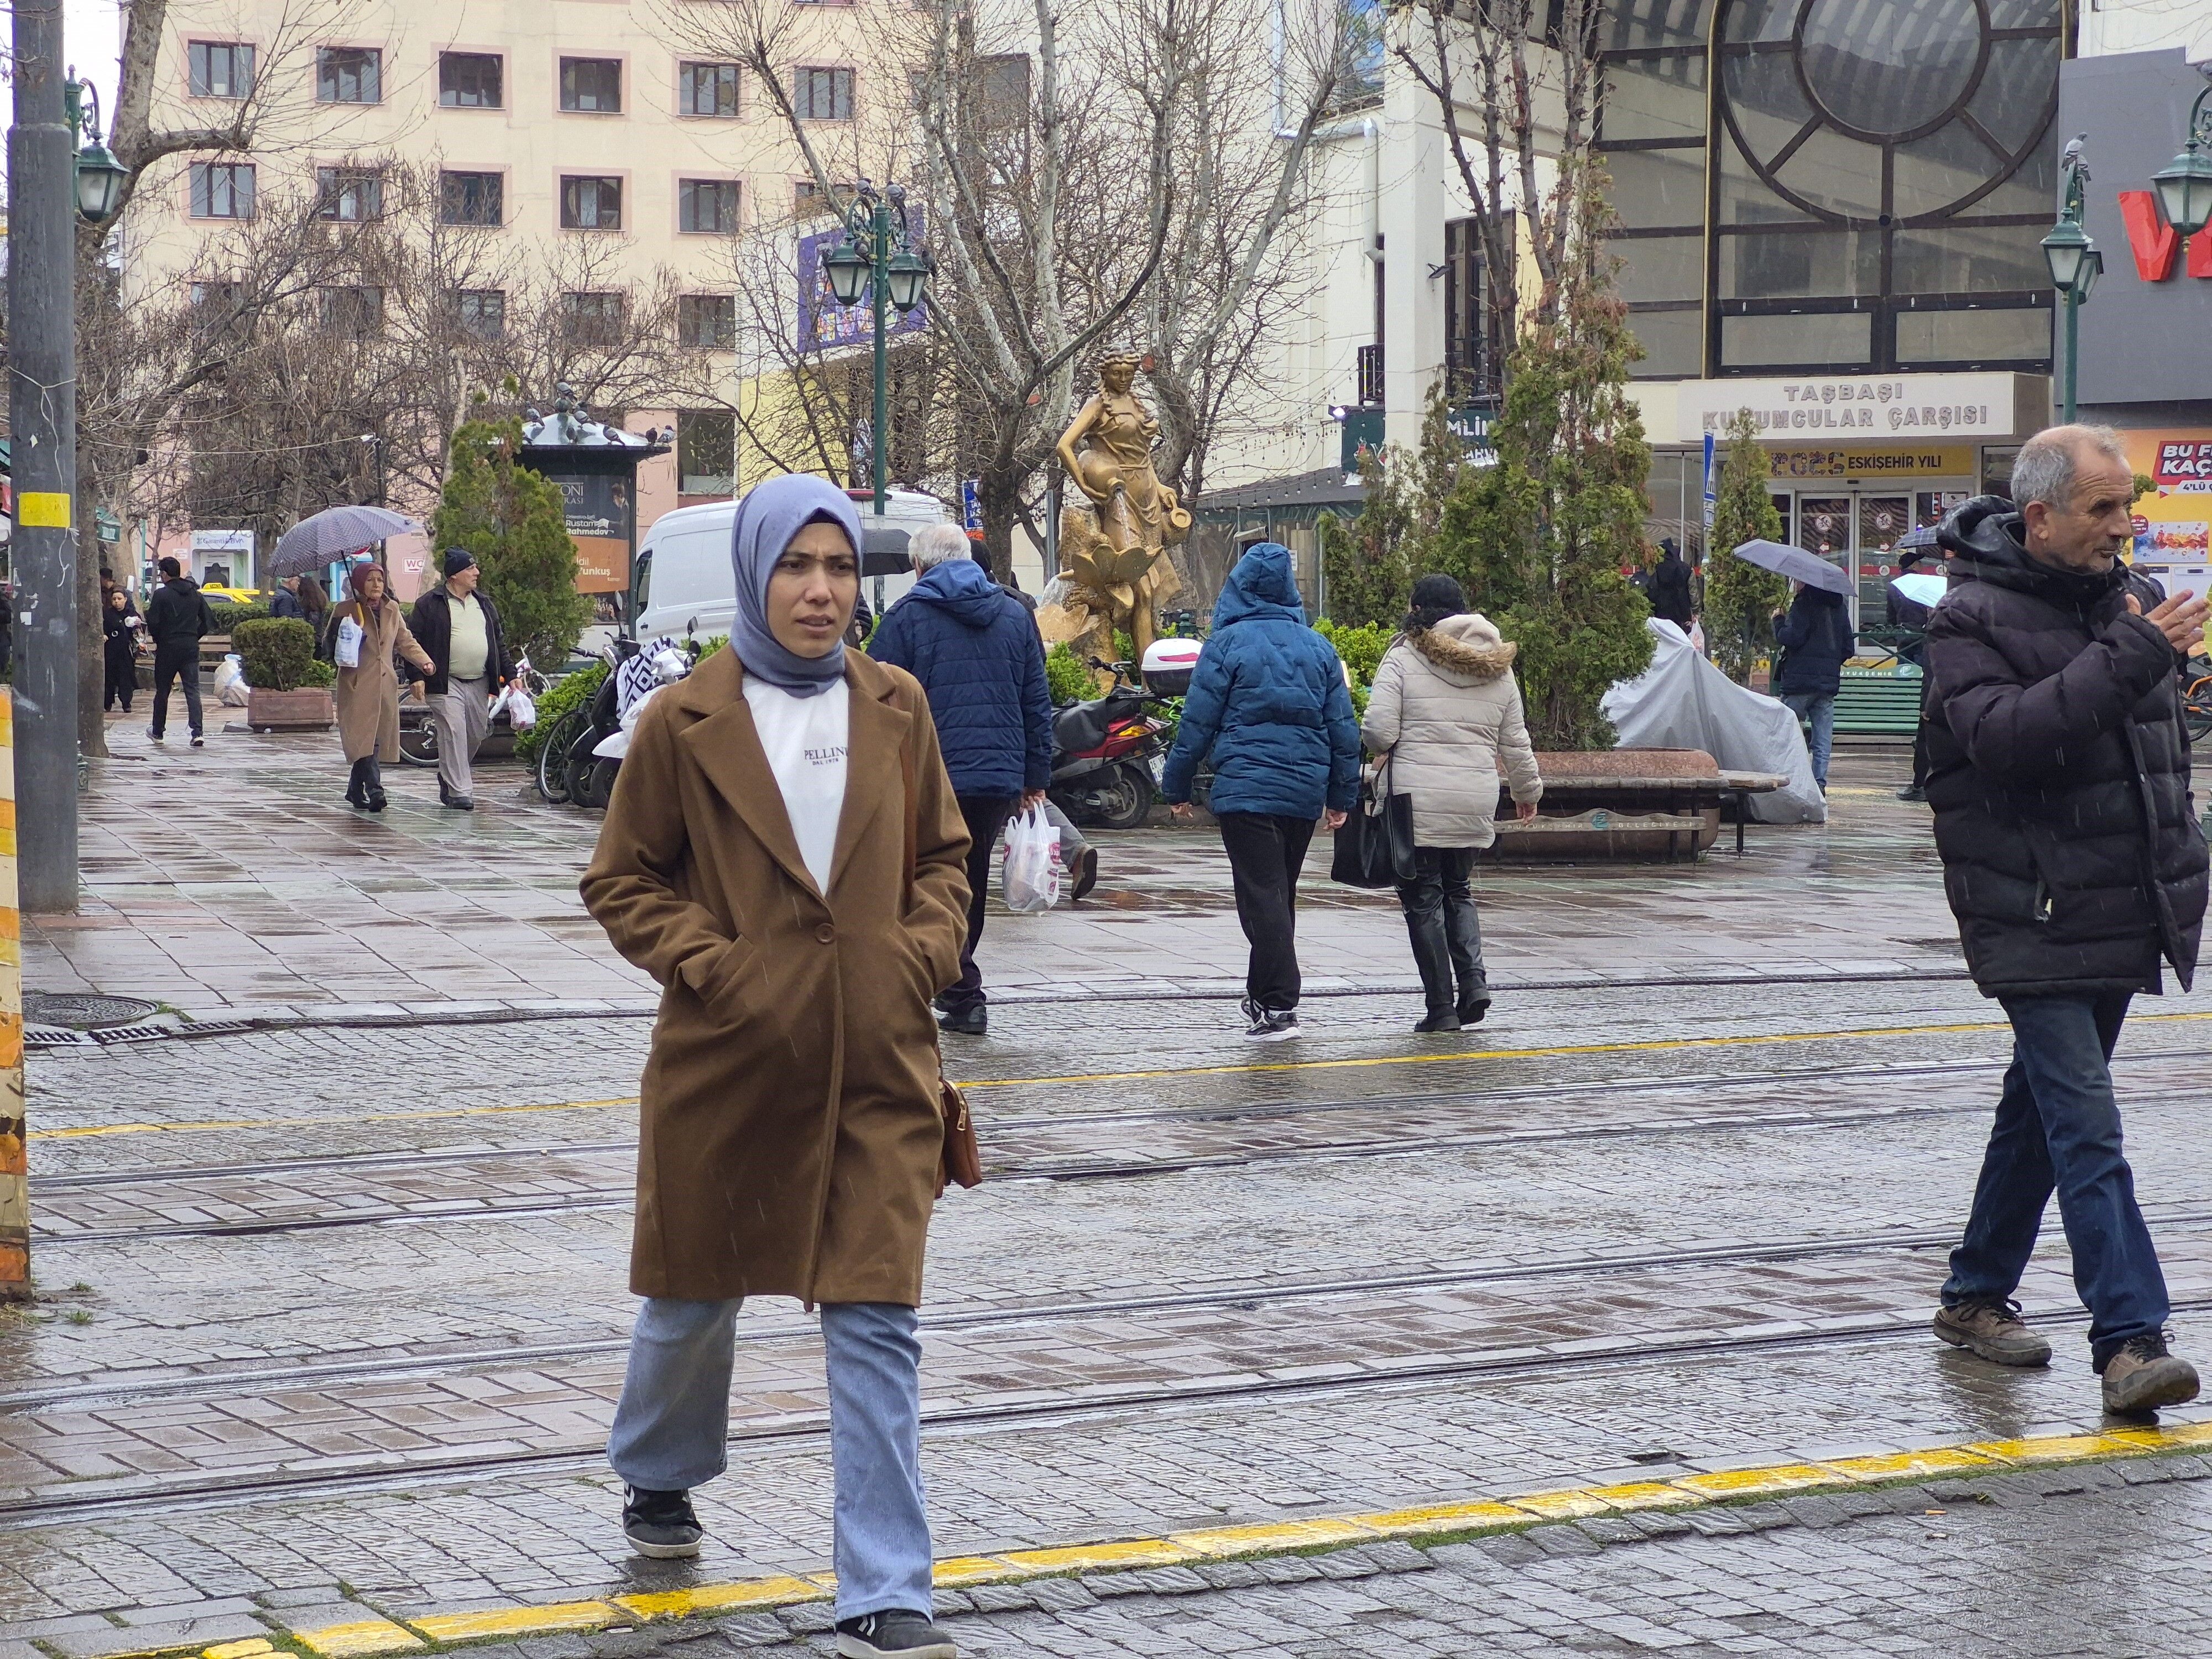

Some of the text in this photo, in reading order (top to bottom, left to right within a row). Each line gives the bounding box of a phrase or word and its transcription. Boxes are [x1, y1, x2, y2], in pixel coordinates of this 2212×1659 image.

[1784, 383, 1903, 404] TAŞBAŞI
[1702, 405, 1987, 430] KUUMCULAR ÇARŞISI
[2163, 444, 2212, 458] BU F
[1848, 453, 1914, 471] ESKİŞEHİR
[1918, 455, 1942, 468] YILI
[2161, 459, 2212, 478] KAÇ
